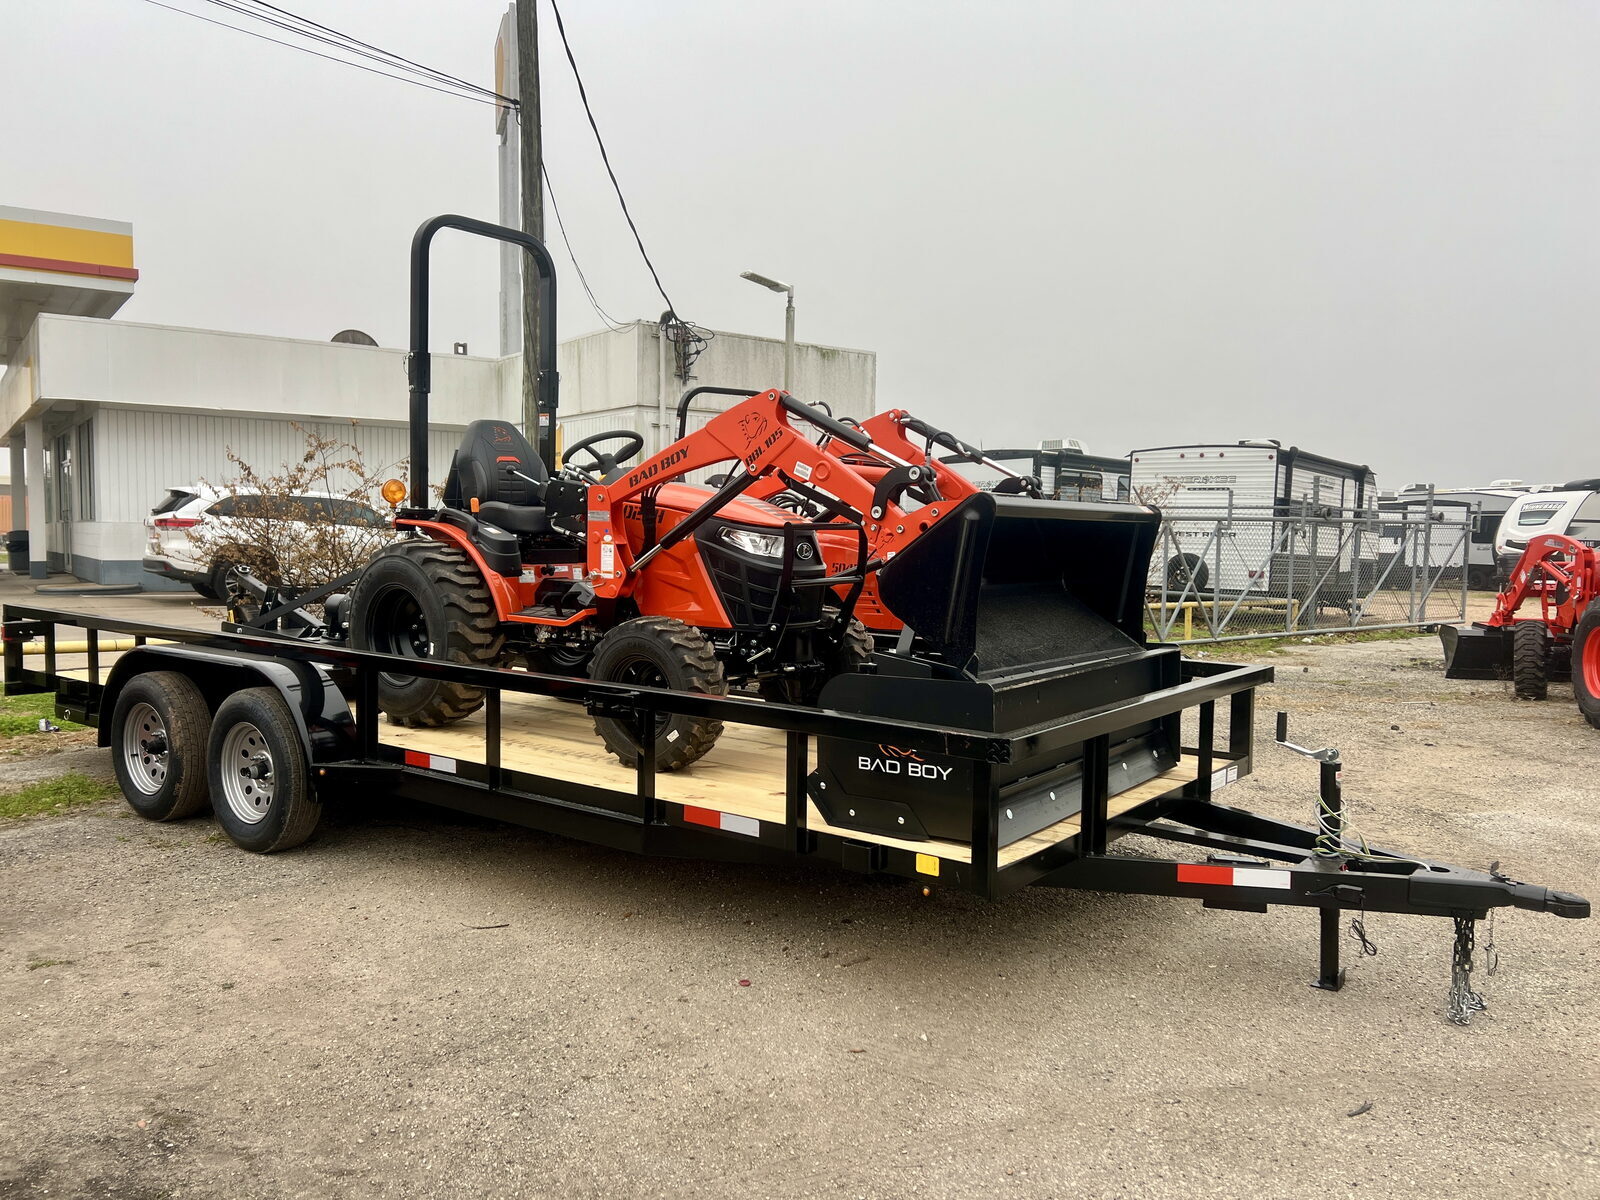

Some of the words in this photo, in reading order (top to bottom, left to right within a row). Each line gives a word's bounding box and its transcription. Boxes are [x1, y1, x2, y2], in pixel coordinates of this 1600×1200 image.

[765, 426, 784, 448] 105
[628, 463, 659, 488] BAD
[660, 445, 690, 471] BOY
[858, 756, 901, 774] BAD
[908, 762, 953, 781] BOY
